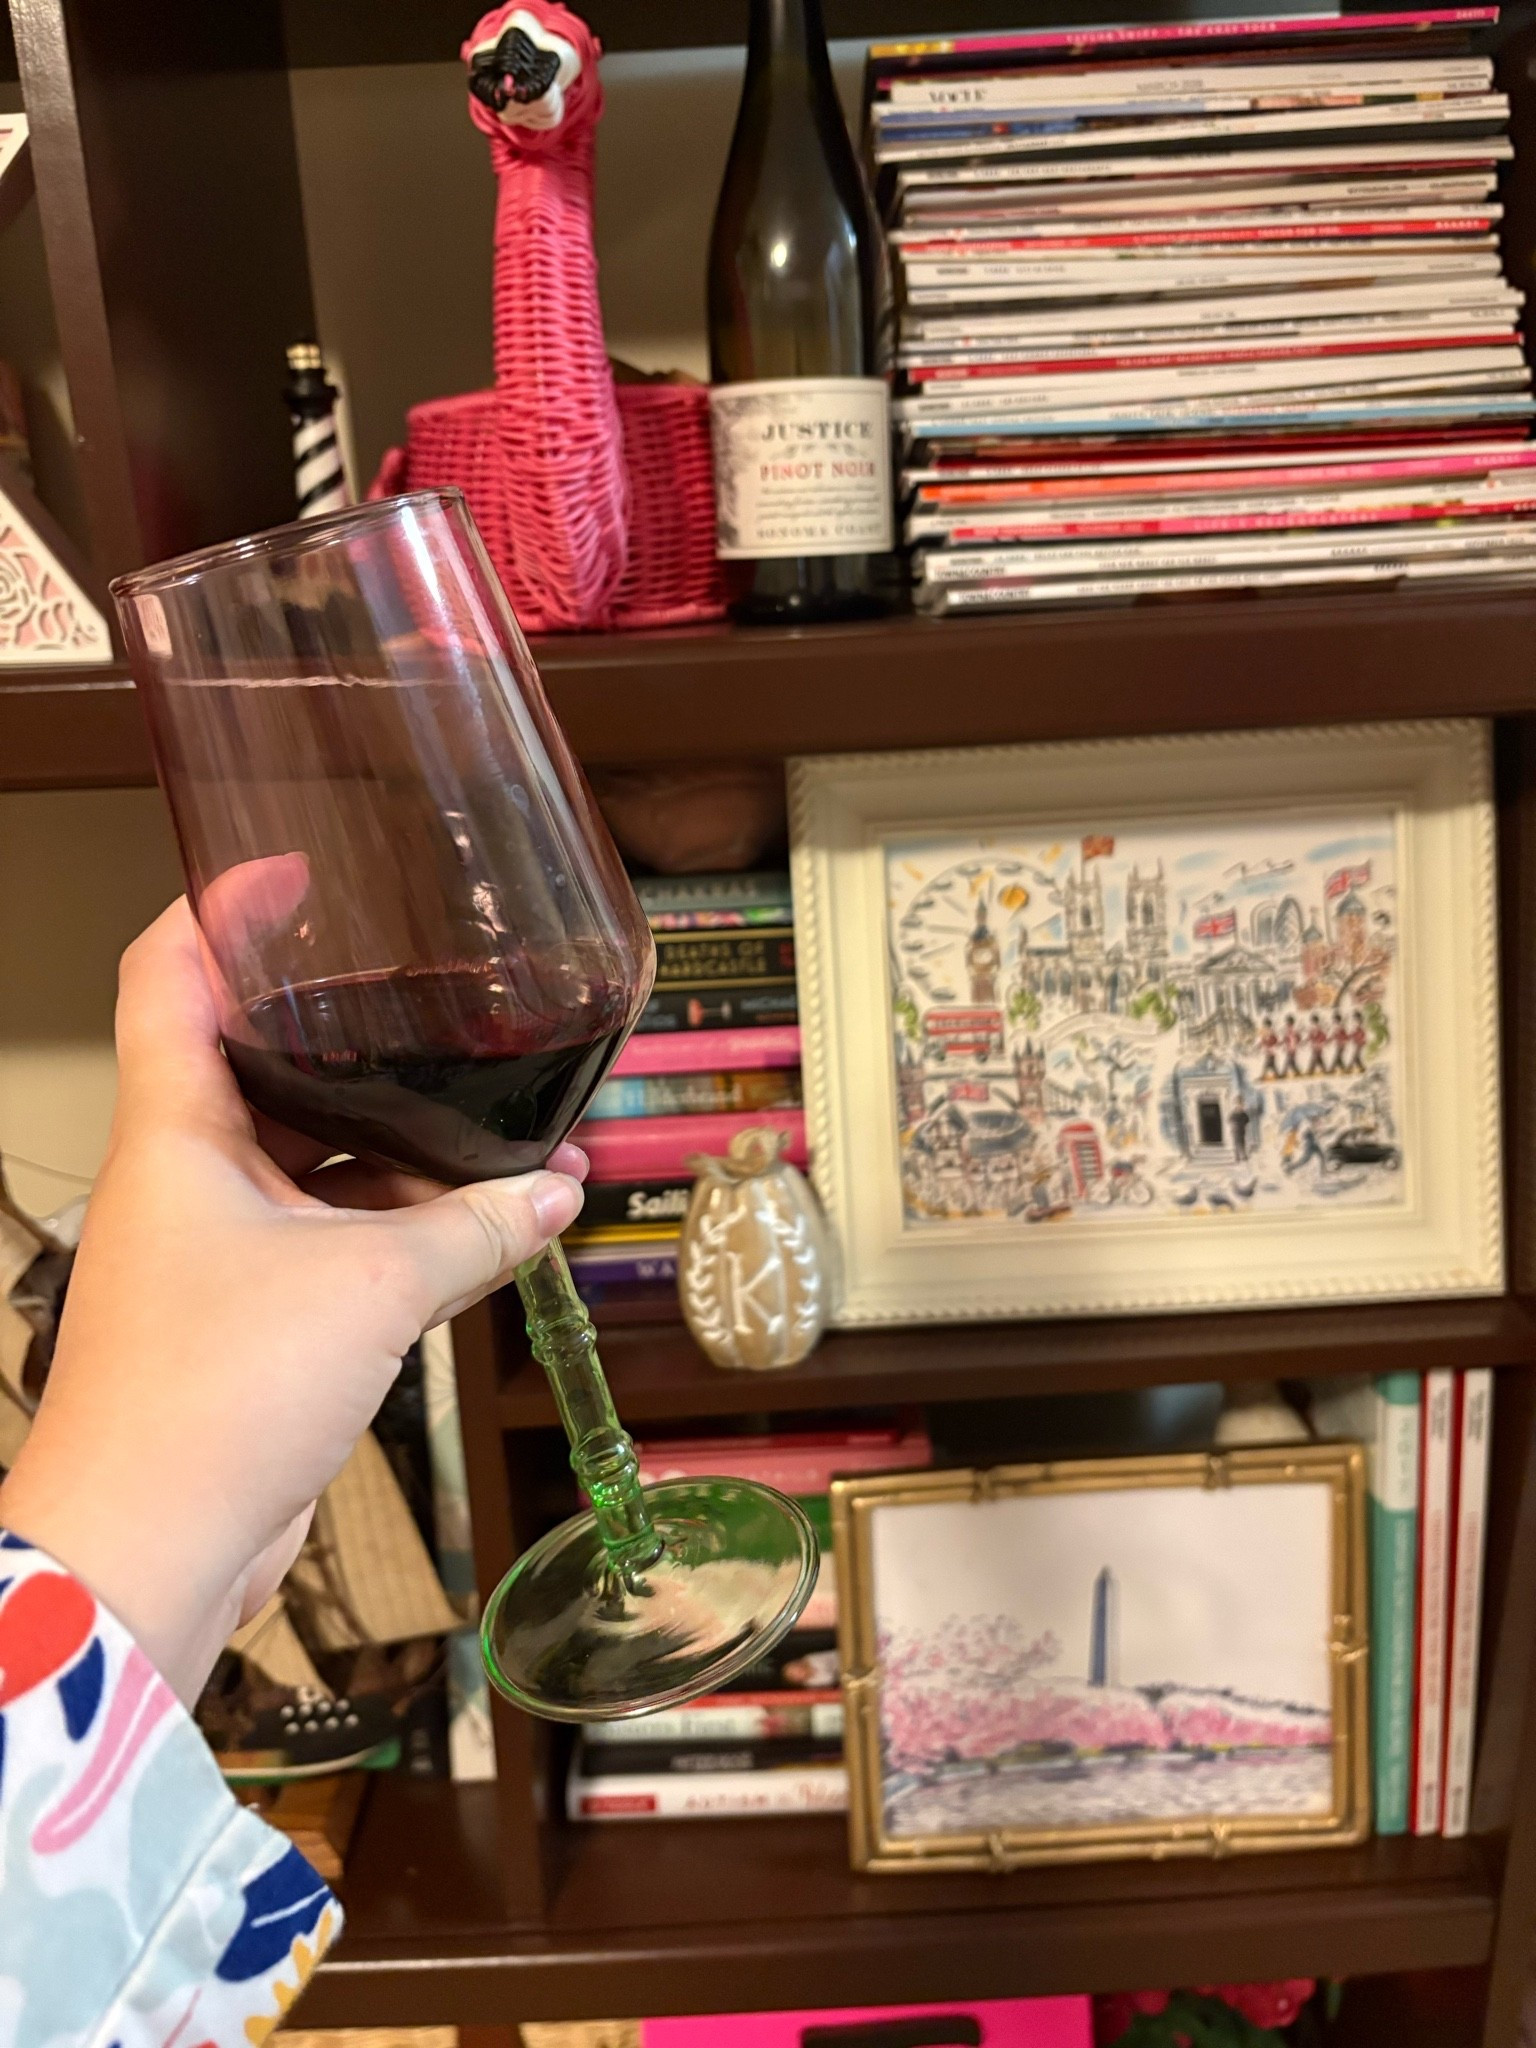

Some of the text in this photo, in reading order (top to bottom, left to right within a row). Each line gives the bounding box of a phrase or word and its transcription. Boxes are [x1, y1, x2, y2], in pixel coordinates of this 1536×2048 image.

[761, 421, 873, 441] JUSTICE
[759, 460, 876, 480] PINOT NOIR
[726, 1250, 786, 1335] K
